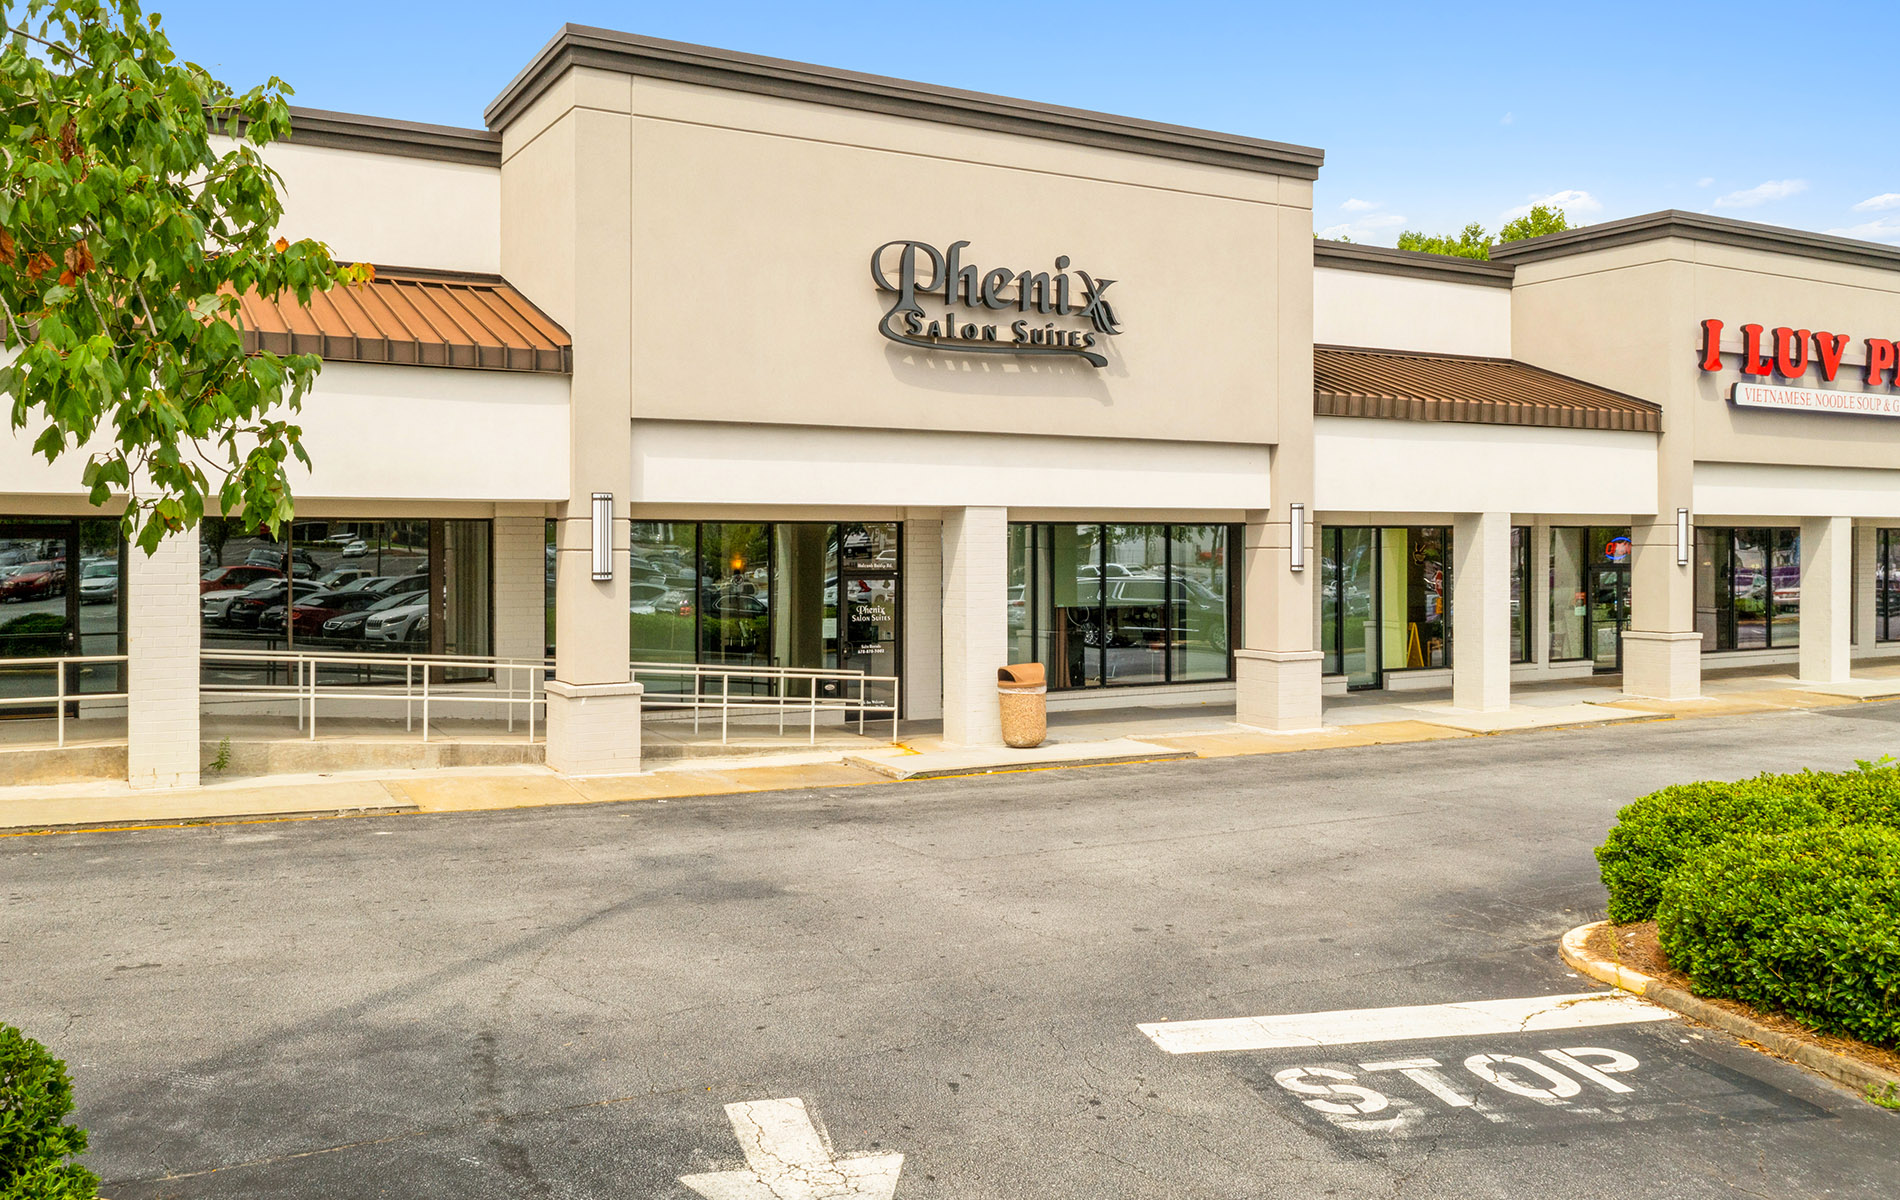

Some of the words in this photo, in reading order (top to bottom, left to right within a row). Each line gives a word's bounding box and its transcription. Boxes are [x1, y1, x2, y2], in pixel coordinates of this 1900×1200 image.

[870, 240, 1125, 336] Phenix
[1698, 319, 1724, 372] I
[1739, 324, 1851, 382] LUV
[1863, 338, 1900, 387] P
[1745, 387, 1812, 407] VIETNAMESE
[1815, 393, 1857, 409] NOODLE
[1857, 396, 1882, 412] SOUP
[1883, 398, 1891, 413] &
[1605, 542, 1632, 555] OPEN
[856, 605, 886, 615] Phenix
[1273, 1046, 1641, 1116] STOP
